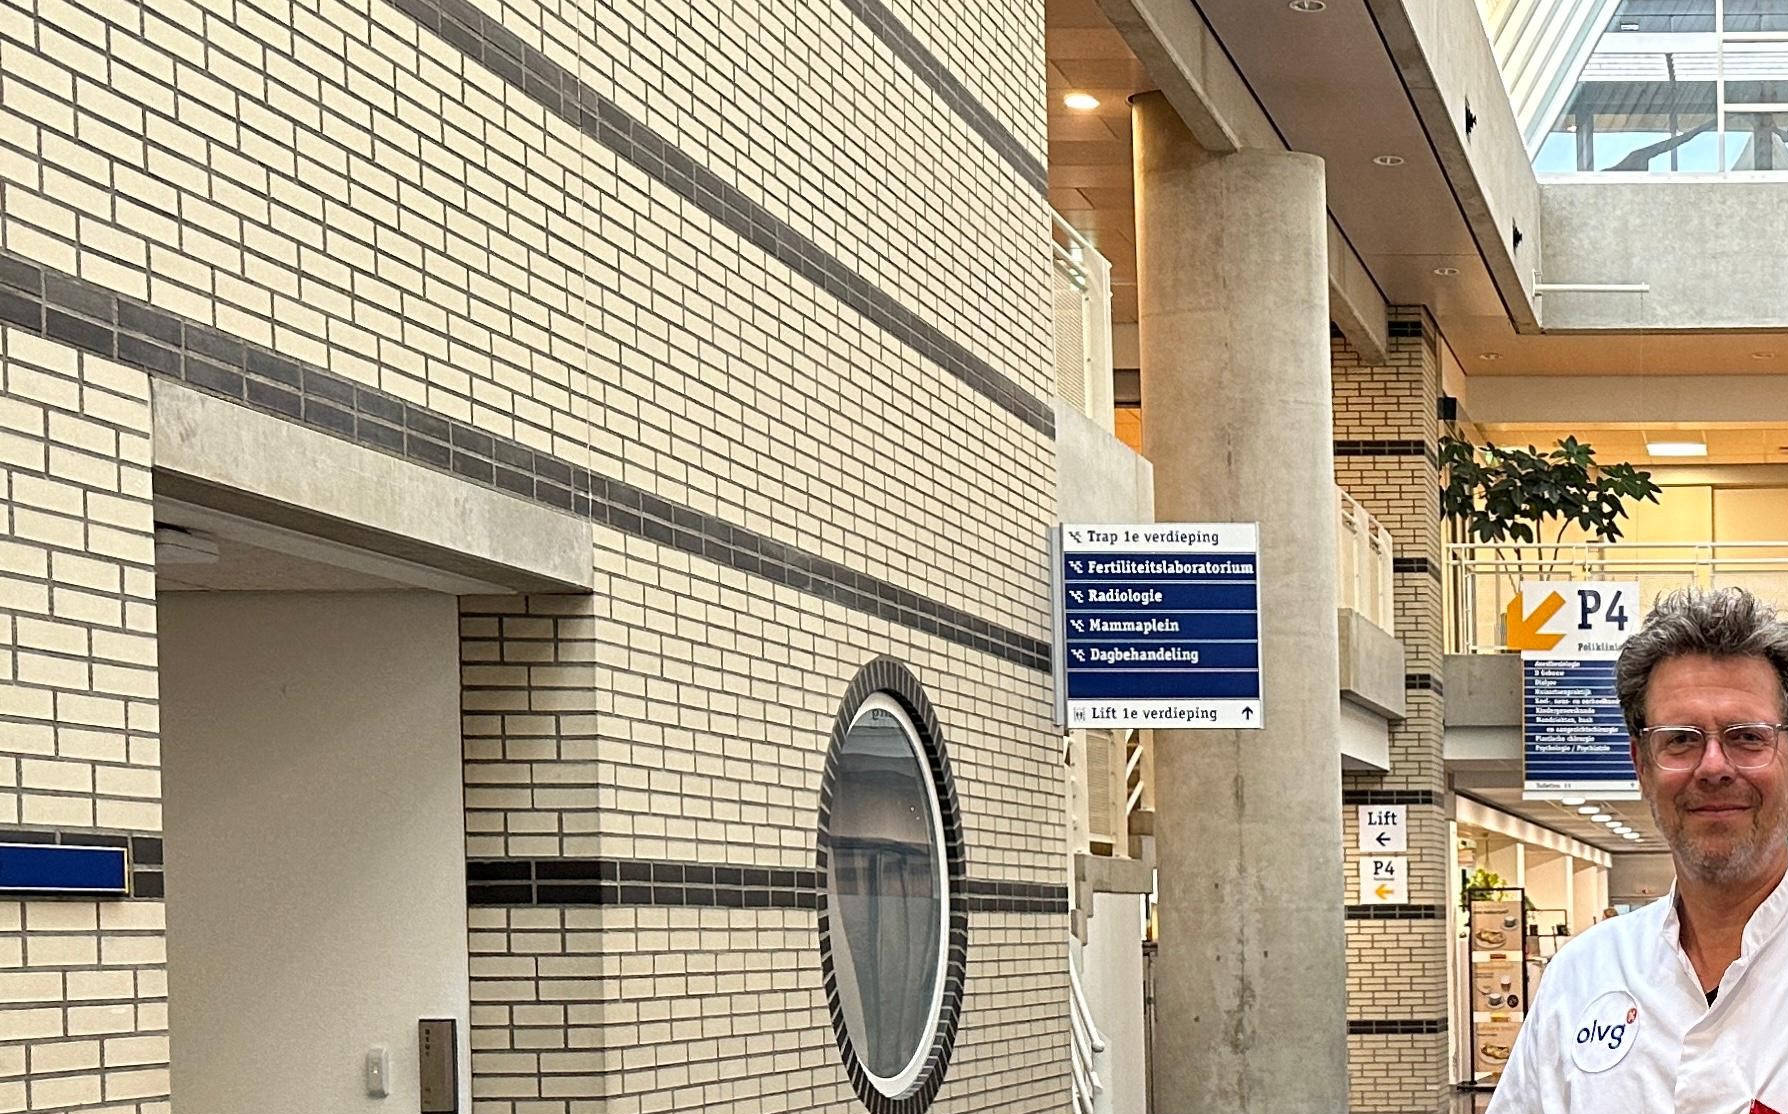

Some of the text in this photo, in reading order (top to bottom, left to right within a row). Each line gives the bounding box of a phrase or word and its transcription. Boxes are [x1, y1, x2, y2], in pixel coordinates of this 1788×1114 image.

[1087, 530, 1219, 545] Trap 1e verdieping
[1087, 560, 1255, 574] Fertiliteitslaboratorium
[1087, 589, 1163, 605] Radiologie
[1577, 589, 1629, 631] P4
[1088, 618, 1180, 634] Mammaplein
[1090, 647, 1199, 663] Dagbehandeling
[1091, 706, 1218, 722] Lift 1e verdieping
[1367, 811, 1398, 826] Lift
[1373, 860, 1395, 876] P4
[1577, 1019, 1626, 1050] olvg
